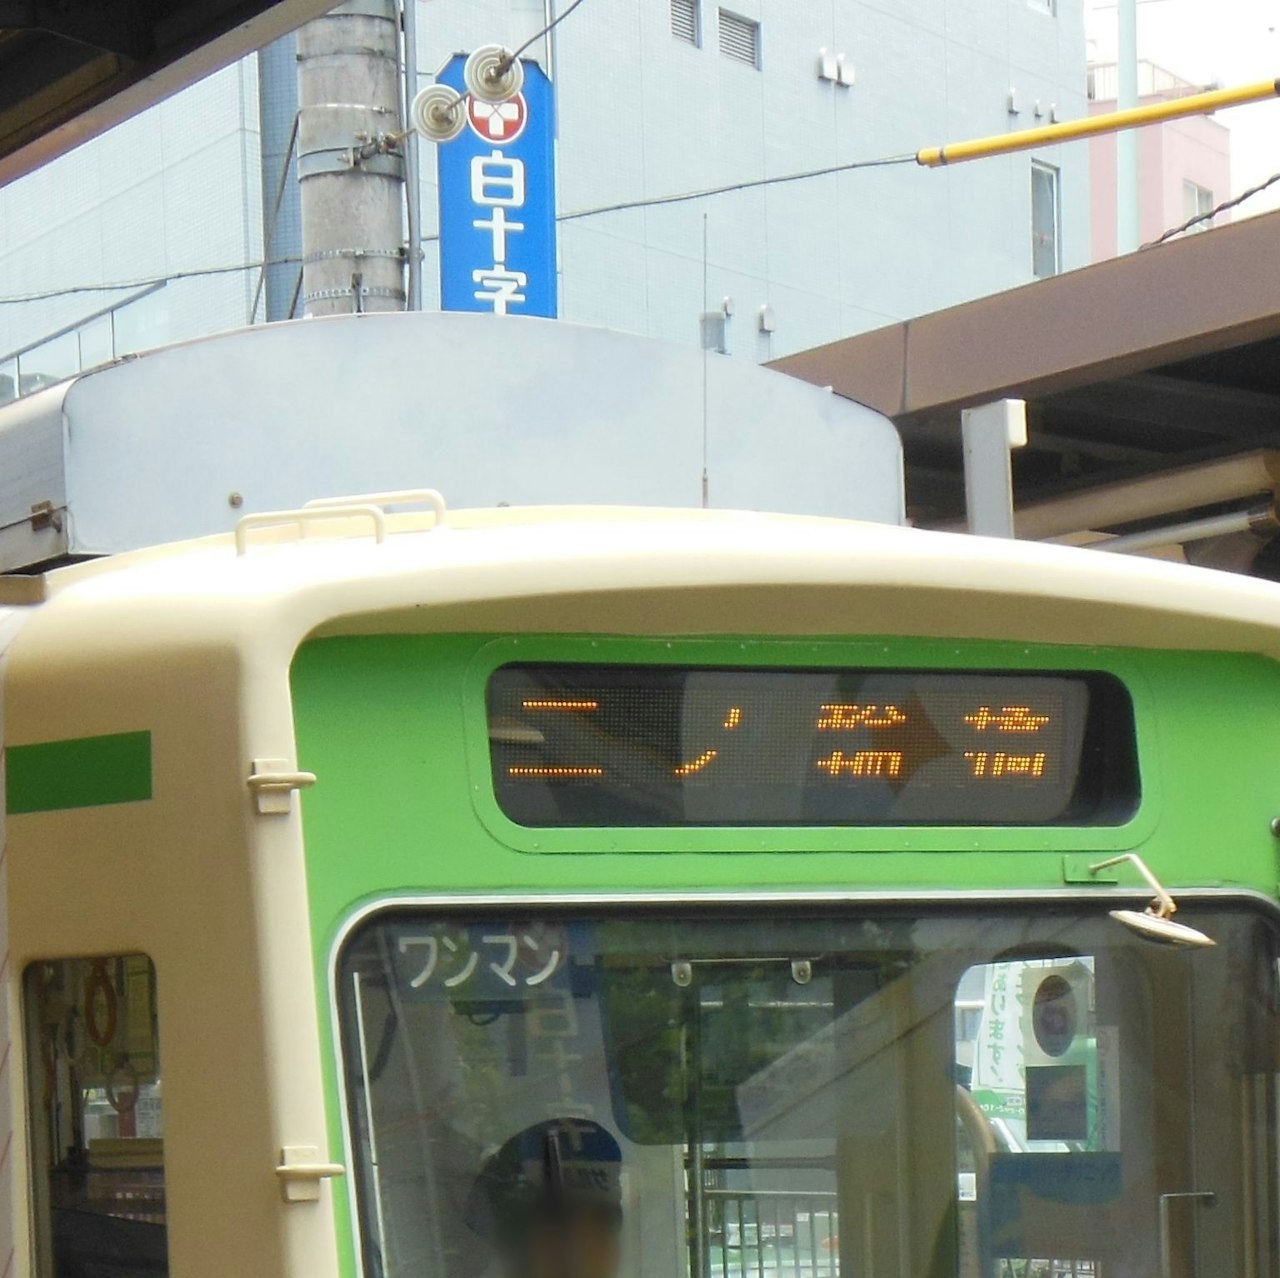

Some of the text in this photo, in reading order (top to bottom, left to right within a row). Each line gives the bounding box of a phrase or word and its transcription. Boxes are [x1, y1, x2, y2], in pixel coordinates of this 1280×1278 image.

[469, 149, 527, 315] 白十字
[398, 935, 560, 988] ワンマン
